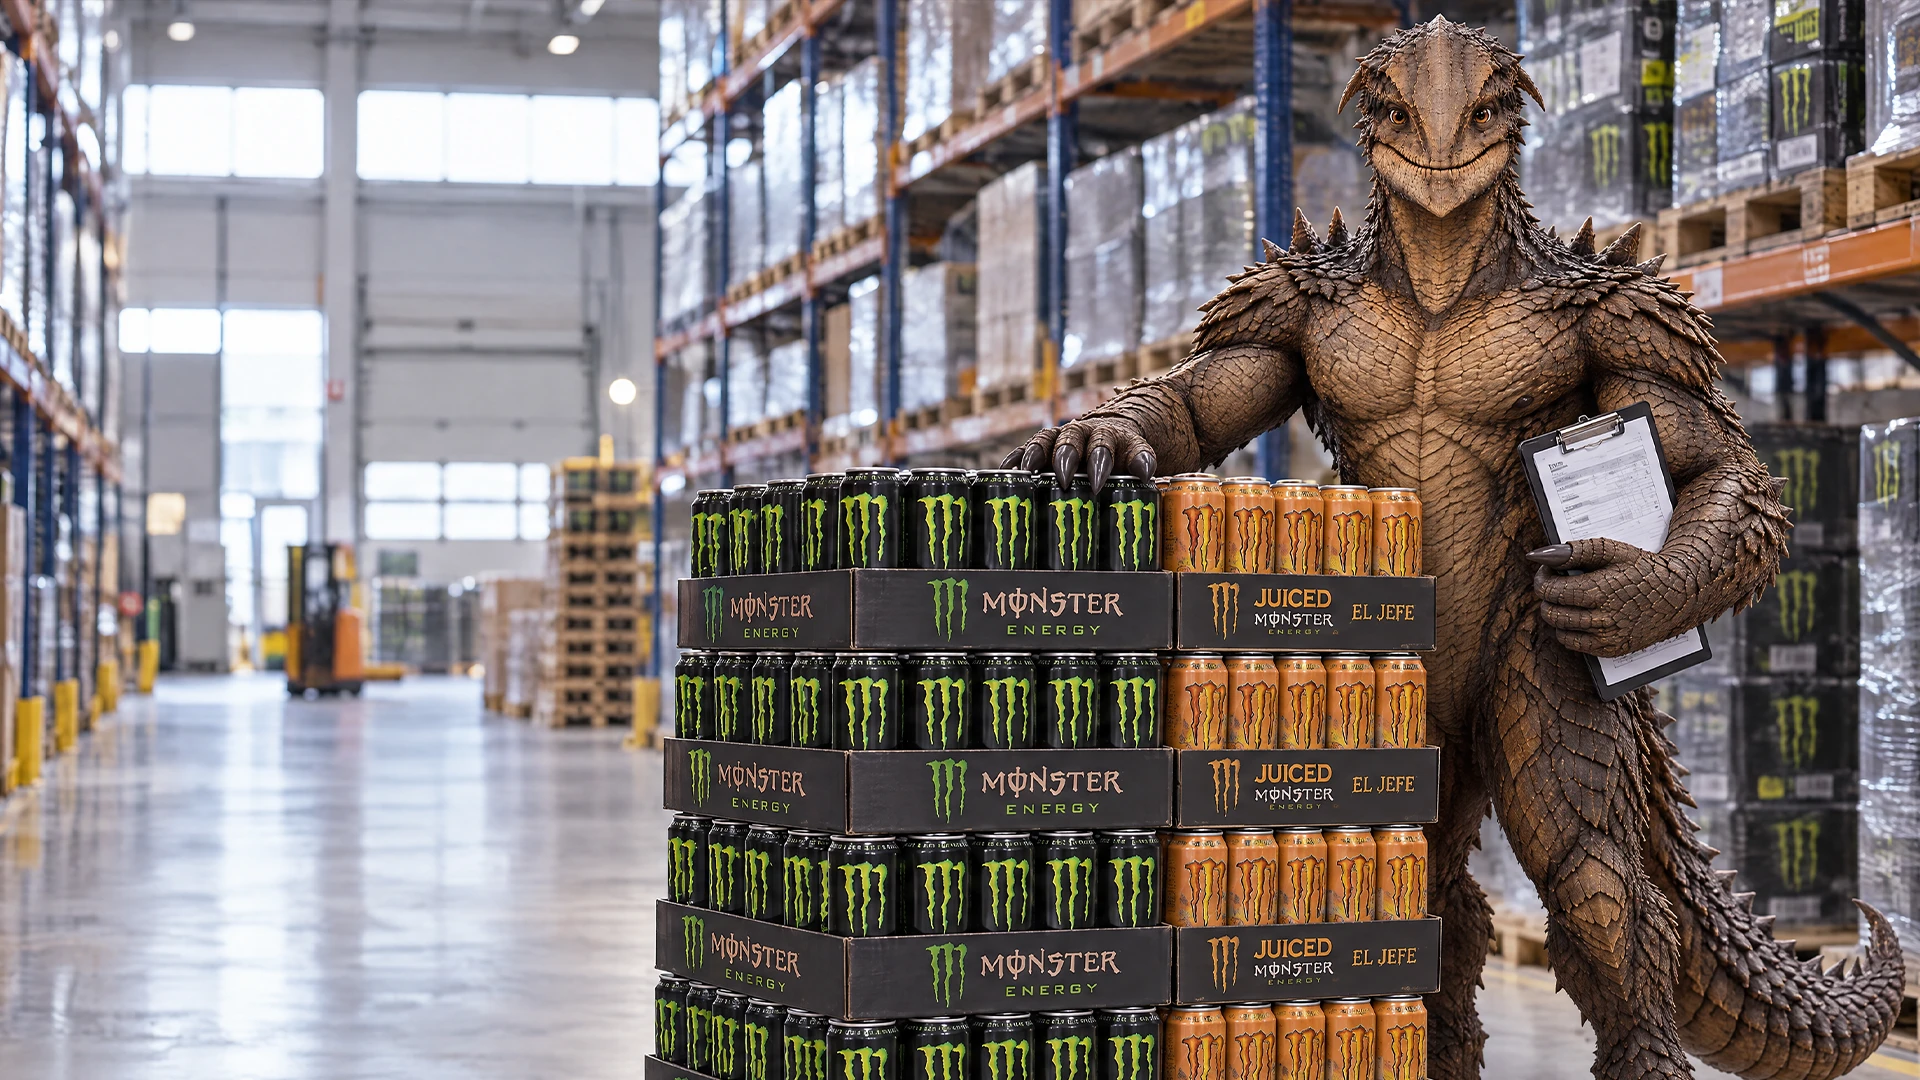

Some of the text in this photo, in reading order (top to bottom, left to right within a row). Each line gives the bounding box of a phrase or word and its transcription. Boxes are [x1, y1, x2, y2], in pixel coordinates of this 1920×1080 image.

[730, 591, 814, 624] MONSTER
[982, 586, 1124, 621] MONSTER
[1254, 588, 1332, 608] JUICED
[1254, 610, 1334, 628] MONSTER
[1351, 603, 1415, 622] EL JEFE
[744, 627, 799, 639] ENERGY
[1007, 624, 1101, 636] ENERGY
[717, 761, 806, 798] MONSTER
[981, 765, 1124, 799] MONSTER
[1254, 763, 1333, 784] JUICED
[1351, 775, 1415, 794] EL JEFE
[1254, 786, 1334, 803] MONSTER
[731, 797, 791, 815] ENERGY
[1006, 803, 1099, 815] ENERGY
[710, 932, 802, 978] MONSTER
[1253, 937, 1332, 959] JUICED
[1351, 947, 1417, 967] EL JEFE
[980, 947, 1122, 980] MONSTER
[1253, 961, 1334, 978] MONSTER
[725, 968, 786, 993] ENERGY
[1005, 982, 1098, 997] ENERGY
[1268, 977, 1321, 985] ENERGY
